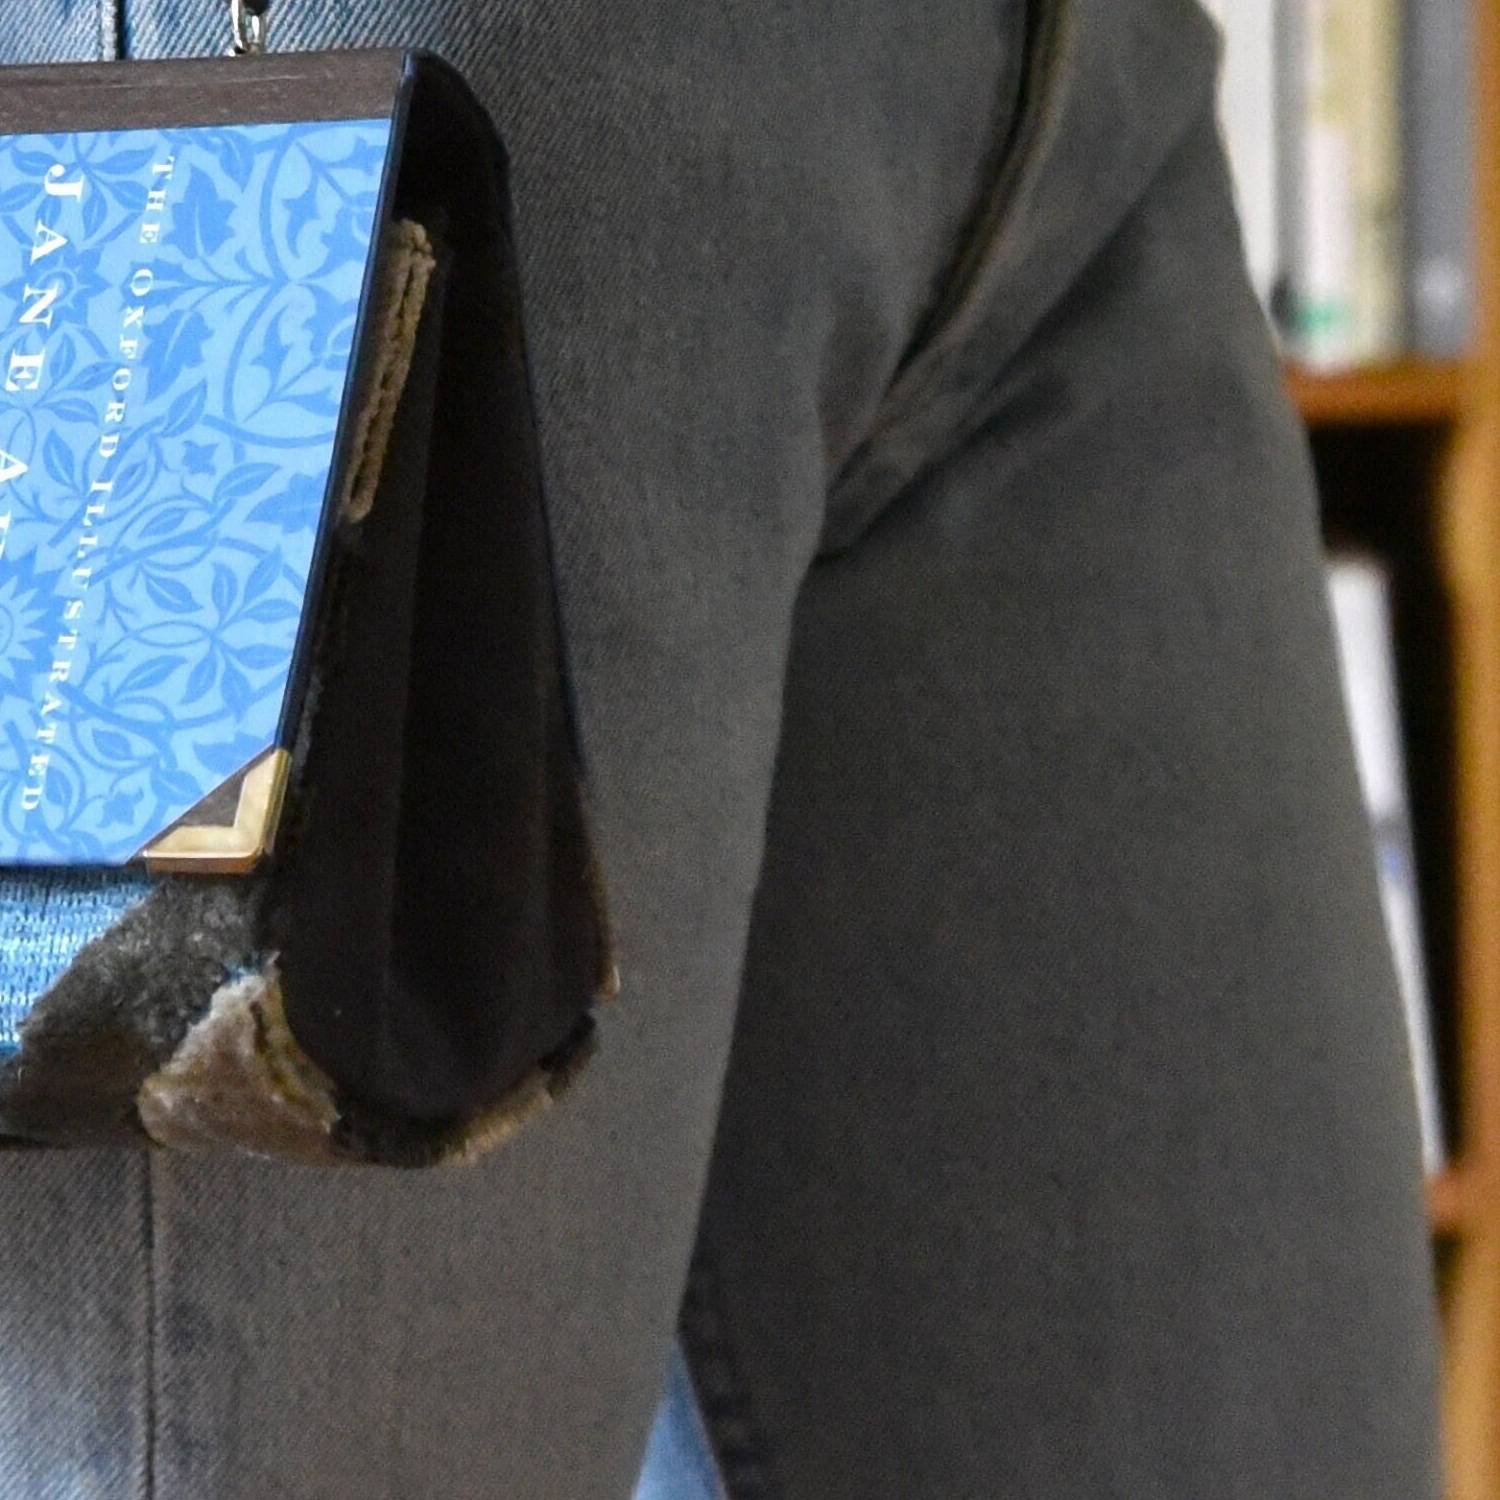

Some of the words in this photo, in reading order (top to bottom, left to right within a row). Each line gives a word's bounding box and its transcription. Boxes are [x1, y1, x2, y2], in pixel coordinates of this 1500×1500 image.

[5, 164, 85, 394] JANE
[139, 155, 175, 244] THE
[98, 267, 154, 458] OXFORD
[21, 477, 115, 812] ILLUSTRATED
